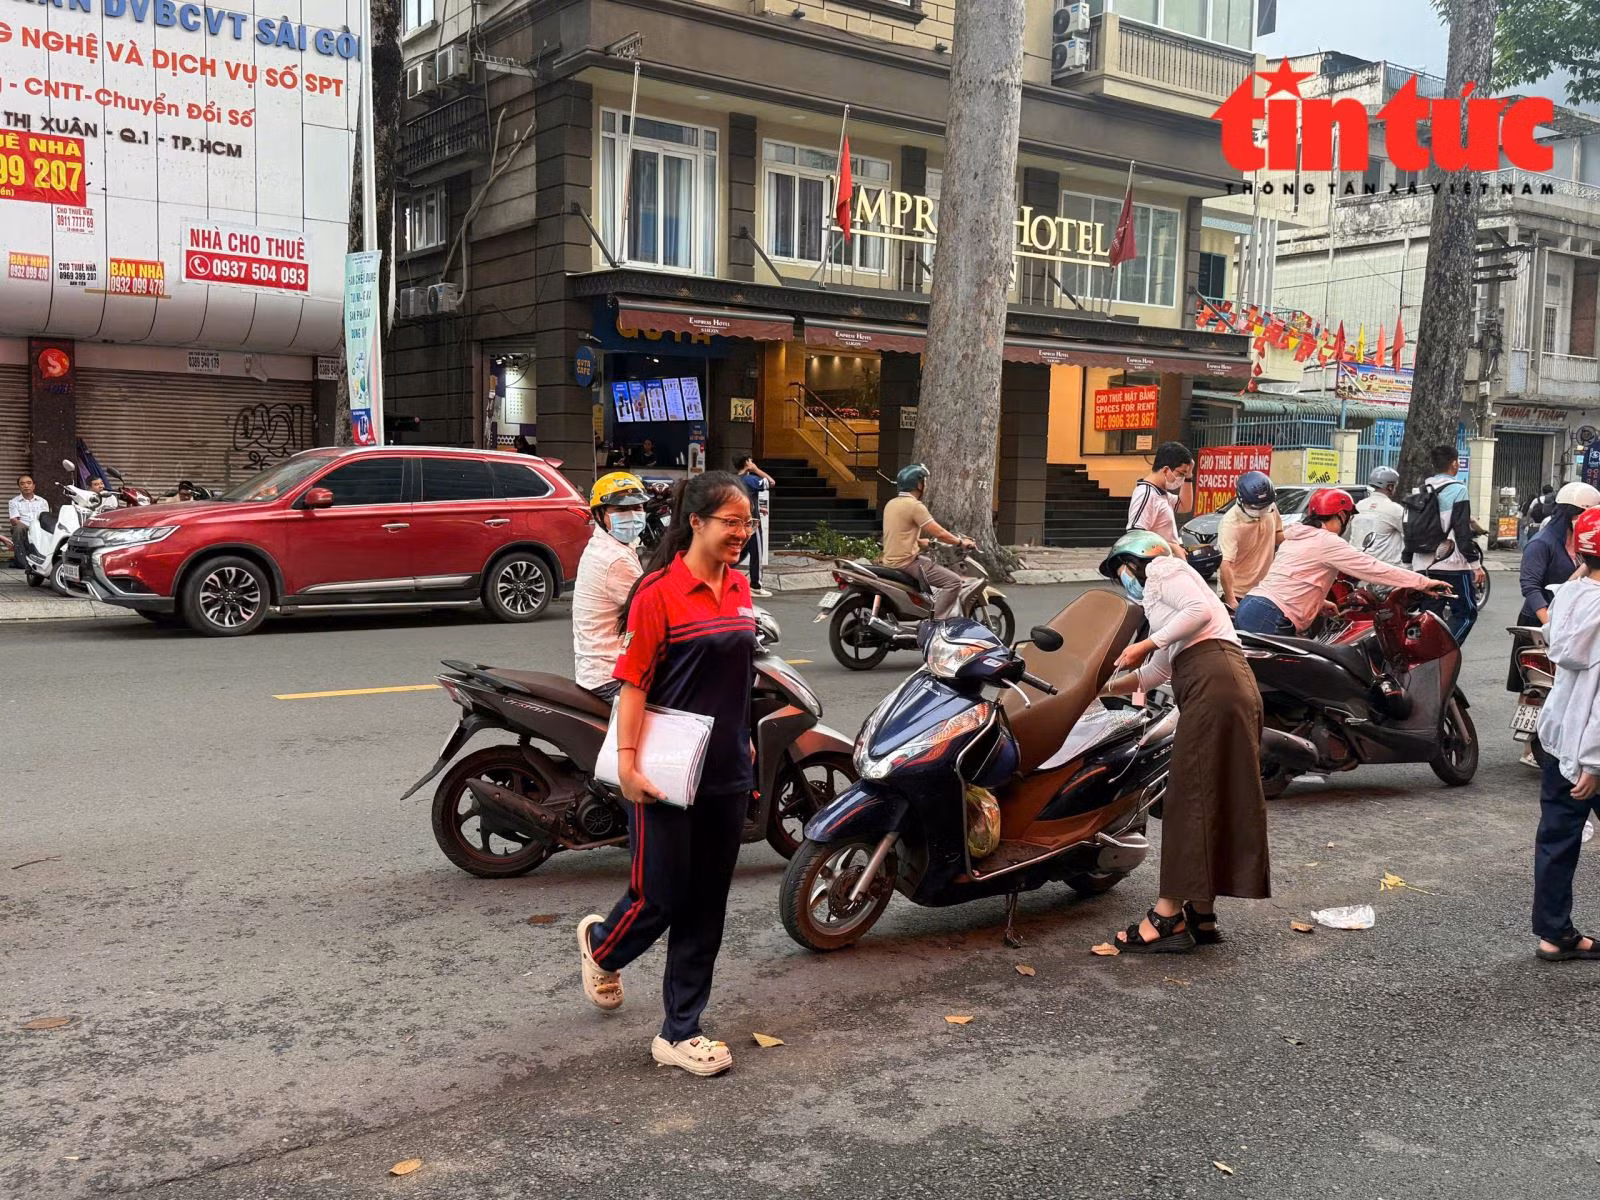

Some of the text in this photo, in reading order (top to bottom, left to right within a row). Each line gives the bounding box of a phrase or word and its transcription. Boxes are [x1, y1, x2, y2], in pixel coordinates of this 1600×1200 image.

[104, 0, 361, 61] DVBCVT SÀI GÒ
[22, 27, 98, 64] NGHỆ
[106, 40, 144, 66] VÀ
[152, 50, 216, 77] DỊCH
[225, 61, 257, 88] VỤ
[265, 64, 298, 89] SỐ
[305, 73, 343, 96] SPT
[187, 101, 221, 123] Đổi
[228, 108, 255, 127] Số
[4, 111, 31, 132] THỊ
[41, 116, 98, 138] XUÂN
[120, 127, 148, 145] Q.1
[29, 138, 82, 157] NHÀ
[34, 158, 82, 192] 207
[190, 226, 305, 260] NHÀ CHO THUÊ
[1013, 205, 1110, 257] HOTEL
[111, 260, 164, 278] BÁN NHÀ
[213, 260, 306, 285] 0937 504 093
[110, 276, 164, 295] 0932 099 478
[1096, 394, 1108, 404] CHO
[1109, 391, 1123, 403] THUÊ
[1096, 401, 1156, 414] SPACES FOR RENT
[1125, 413, 1139, 427] 323
[1200, 454, 1214, 470] CHO
[1215, 451, 1232, 470] THUÊ
[1233, 452, 1248, 474] MẶT
[1199, 474, 1239, 488] SPACES FO
